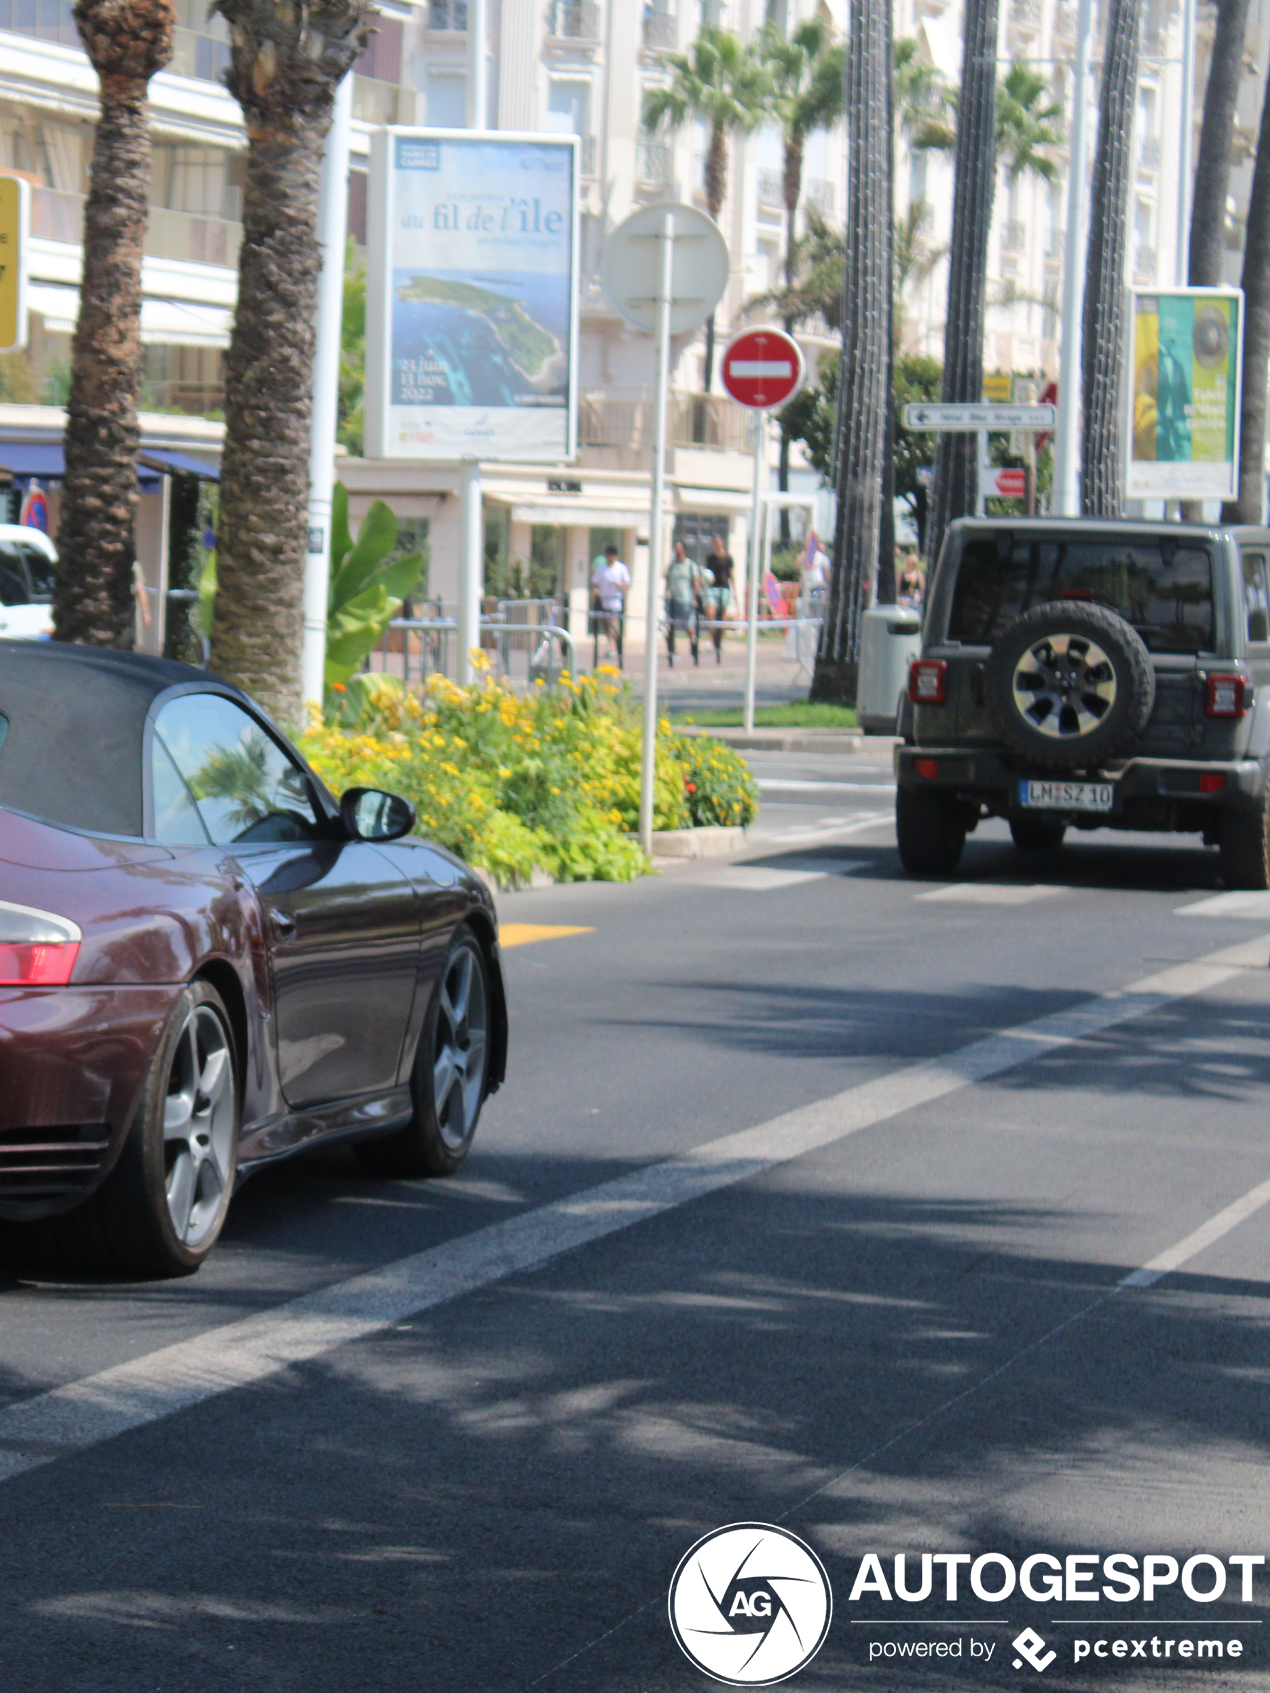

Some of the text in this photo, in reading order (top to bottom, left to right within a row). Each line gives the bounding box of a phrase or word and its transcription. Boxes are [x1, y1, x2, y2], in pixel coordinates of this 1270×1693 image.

[400, 213, 425, 229] au
[432, 202, 459, 231] fil
[466, 203, 494, 231] de
[401, 355, 449, 374] 23 juin
[401, 373, 448, 387] 13 nov.
[400, 387, 434, 400] 2022
